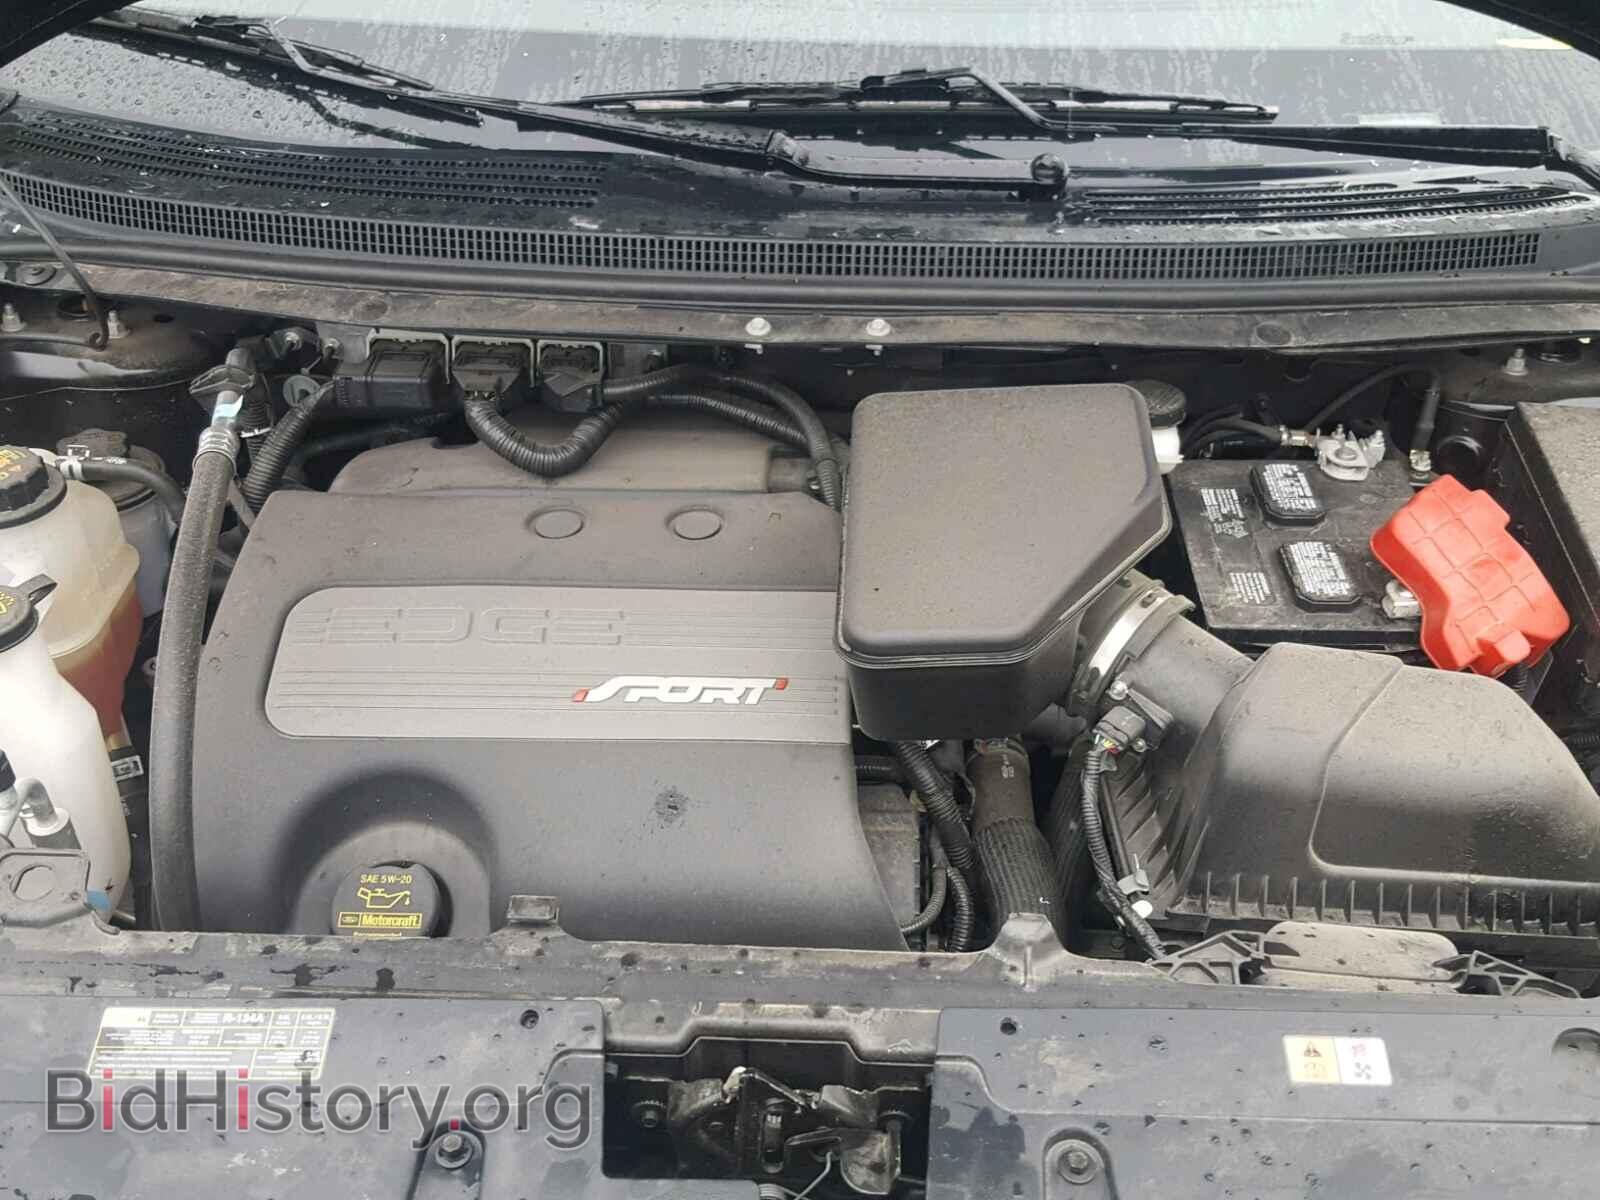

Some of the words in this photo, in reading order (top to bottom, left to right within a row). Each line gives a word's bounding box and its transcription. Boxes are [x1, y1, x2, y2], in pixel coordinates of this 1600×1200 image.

[324, 607, 625, 646] EDGE
[574, 676, 788, 705] SPORT
[360, 874, 379, 884] SAE
[381, 874, 412, 884] 5W-20
[362, 914, 418, 928] Motorcraft
